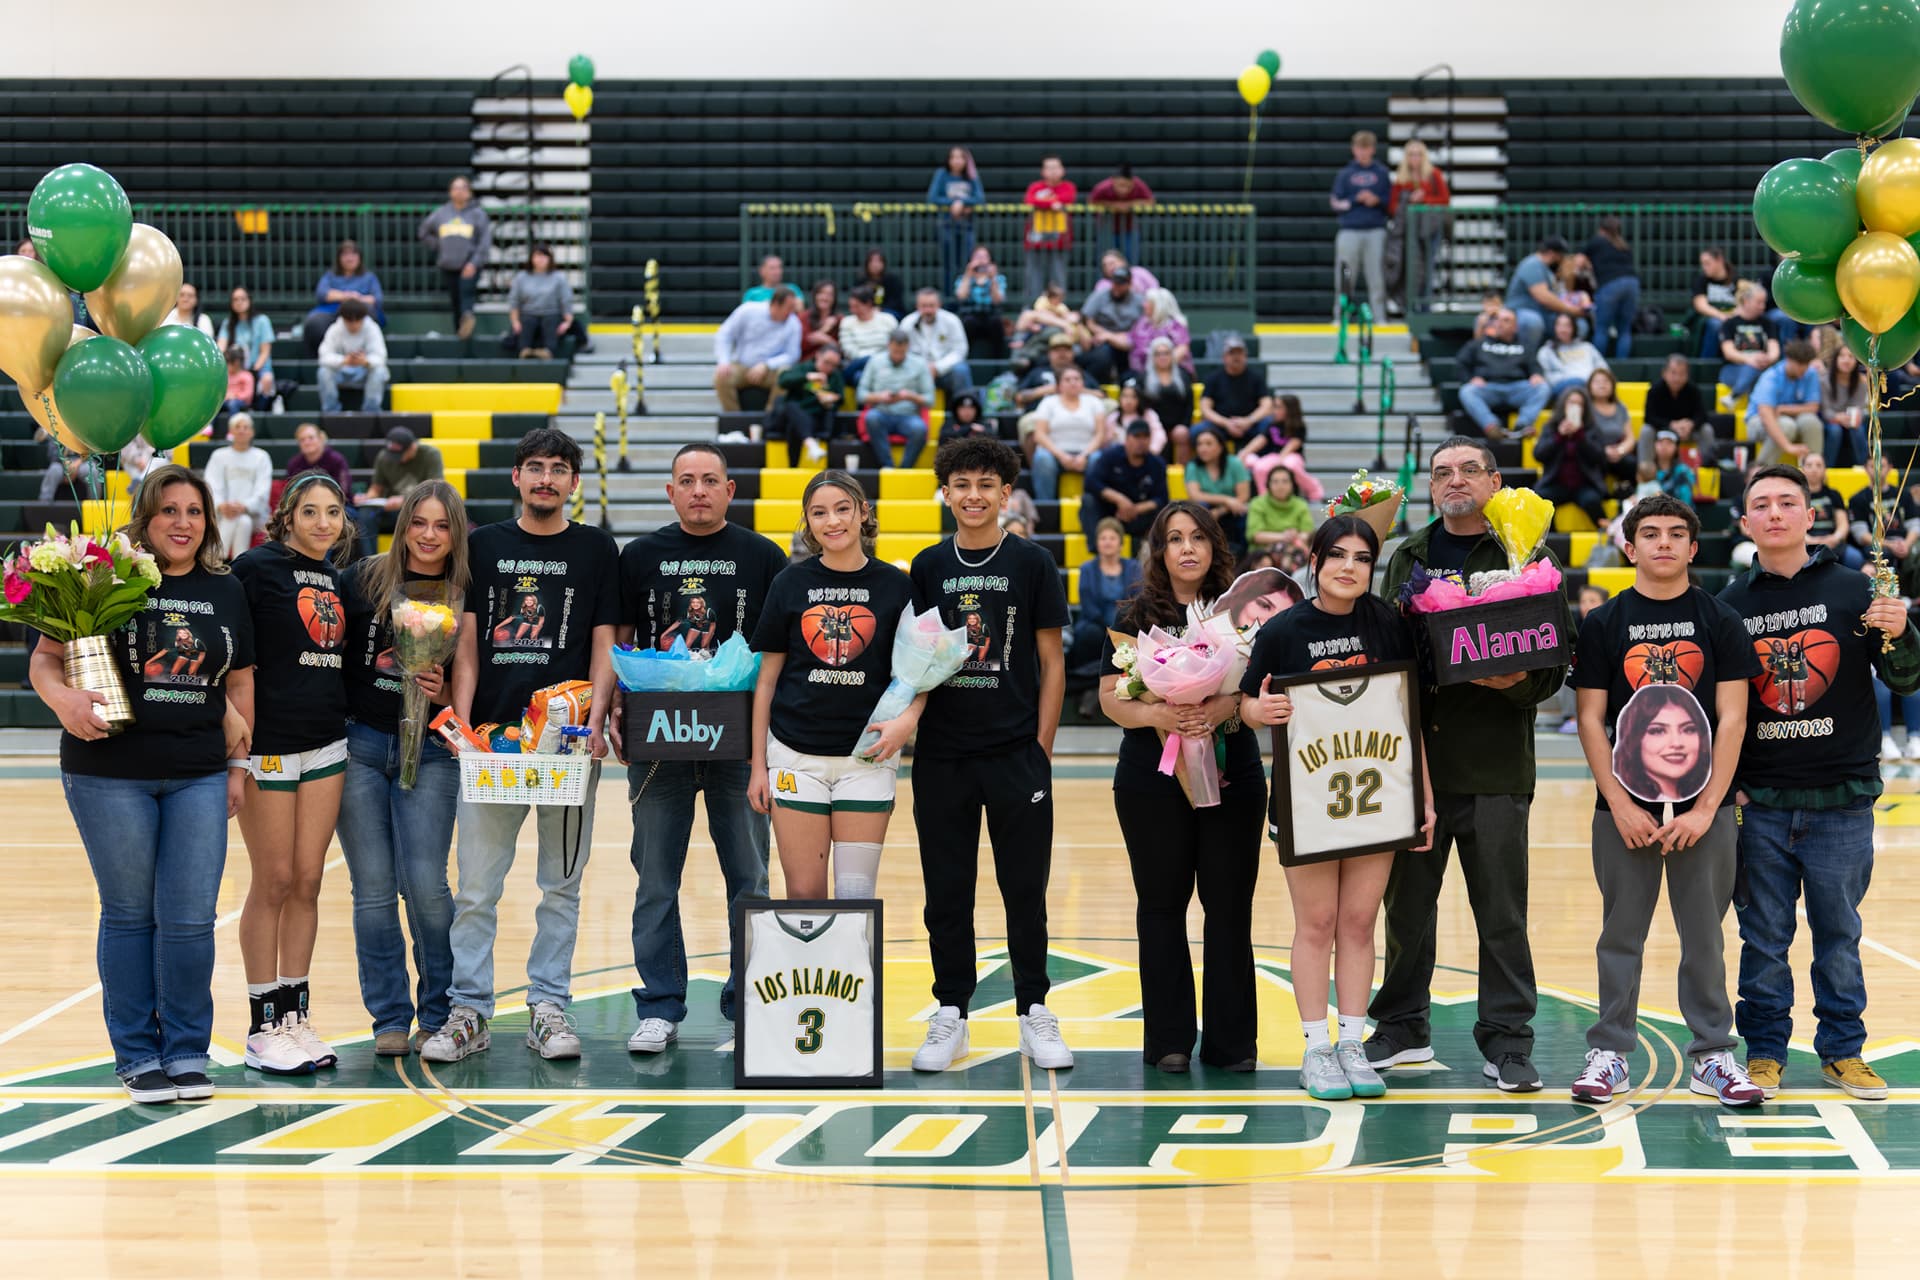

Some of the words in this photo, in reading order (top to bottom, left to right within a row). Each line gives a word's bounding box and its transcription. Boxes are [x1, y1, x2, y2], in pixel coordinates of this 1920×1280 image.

[497, 559, 515, 573] WE
[514, 560, 544, 574] LOVE
[544, 561, 568, 575] OUR
[660, 561, 680, 575] WE
[679, 560, 710, 575] LOVE
[710, 560, 737, 575] OUR
[957, 575, 984, 591] LOVE
[984, 575, 1009, 592] OUR
[808, 588, 824, 604] WE
[824, 587, 850, 602] LOVE
[849, 588, 870, 603] OUR
[158, 598, 189, 612] LOVE
[189, 601, 215, 615] OUR
[1742, 615, 1766, 636] WE
[1765, 609, 1800, 632] LOVE
[1798, 603, 1828, 625] OUR
[1628, 624, 1647, 641] WE
[1646, 623, 1673, 640] LOVE
[1672, 621, 1695, 637] OUR
[1307, 641, 1326, 659] WE
[1325, 637, 1351, 656] LOVE
[1450, 622, 1559, 665] Alanna
[492, 652, 550, 665] SENIOR
[808, 668, 866, 686] SENIORS
[144, 688, 207, 704] SENIOR
[646, 709, 724, 751] Abby
[1757, 717, 1834, 740] SENIORS
[1297, 738, 1328, 774] LOS
[1333, 730, 1403, 762] ALAMOS
[476, 768, 569, 789] ABBY
[1327, 767, 1383, 820] 32
[753, 971, 788, 1005] LOS
[792, 968, 865, 1003] ALAMOS
[795, 1007, 826, 1055] 3
